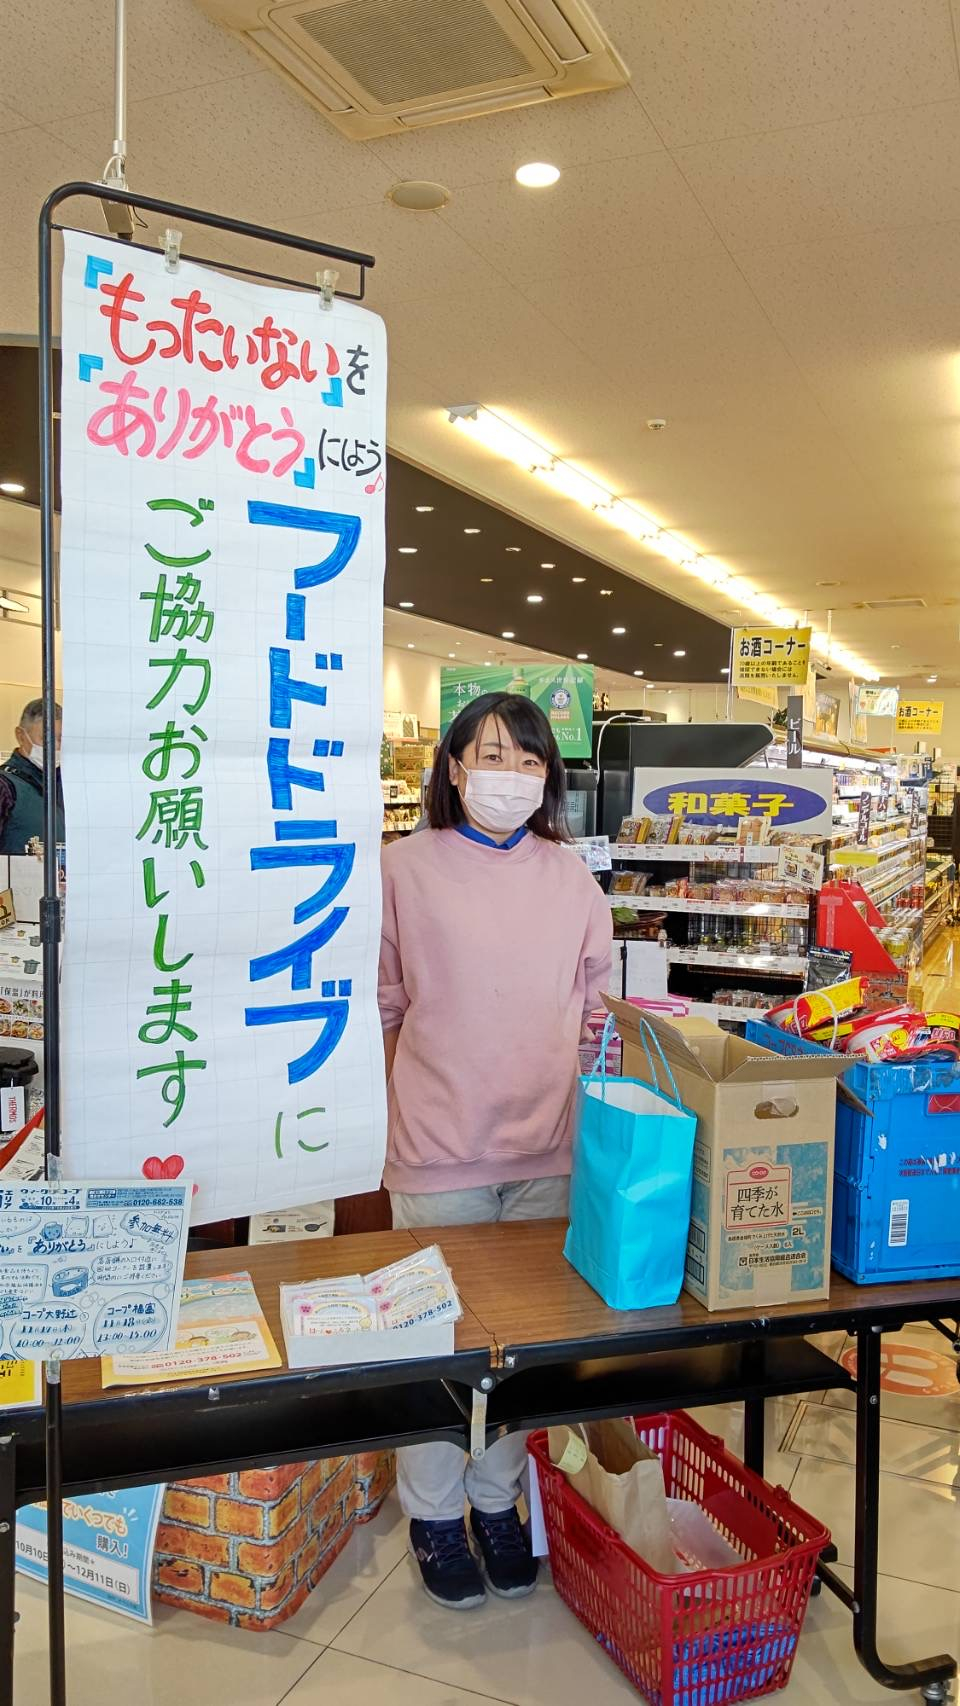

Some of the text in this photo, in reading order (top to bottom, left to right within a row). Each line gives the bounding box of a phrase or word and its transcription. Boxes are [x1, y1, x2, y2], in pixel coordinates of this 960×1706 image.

[740, 636, 806, 657] お酒コーナー
[898, 706, 939, 717] お酒コーナー
[788, 719, 802, 755] ビール
[136, 498, 215, 1129] ご協力お願いします
[667, 791, 795, 817] 和菓子
[858, 793, 872, 842] ノンアルコール
[738, 1186, 778, 1202] 四季が
[731, 1201, 784, 1221] 育てた水
[128, 1214, 174, 1243] 参加無料
[792, 1227, 804, 1236] 2L
[166, 1352, 242, 1367] 0120-378-502
[97, 1535, 129, 1558] 購入!
